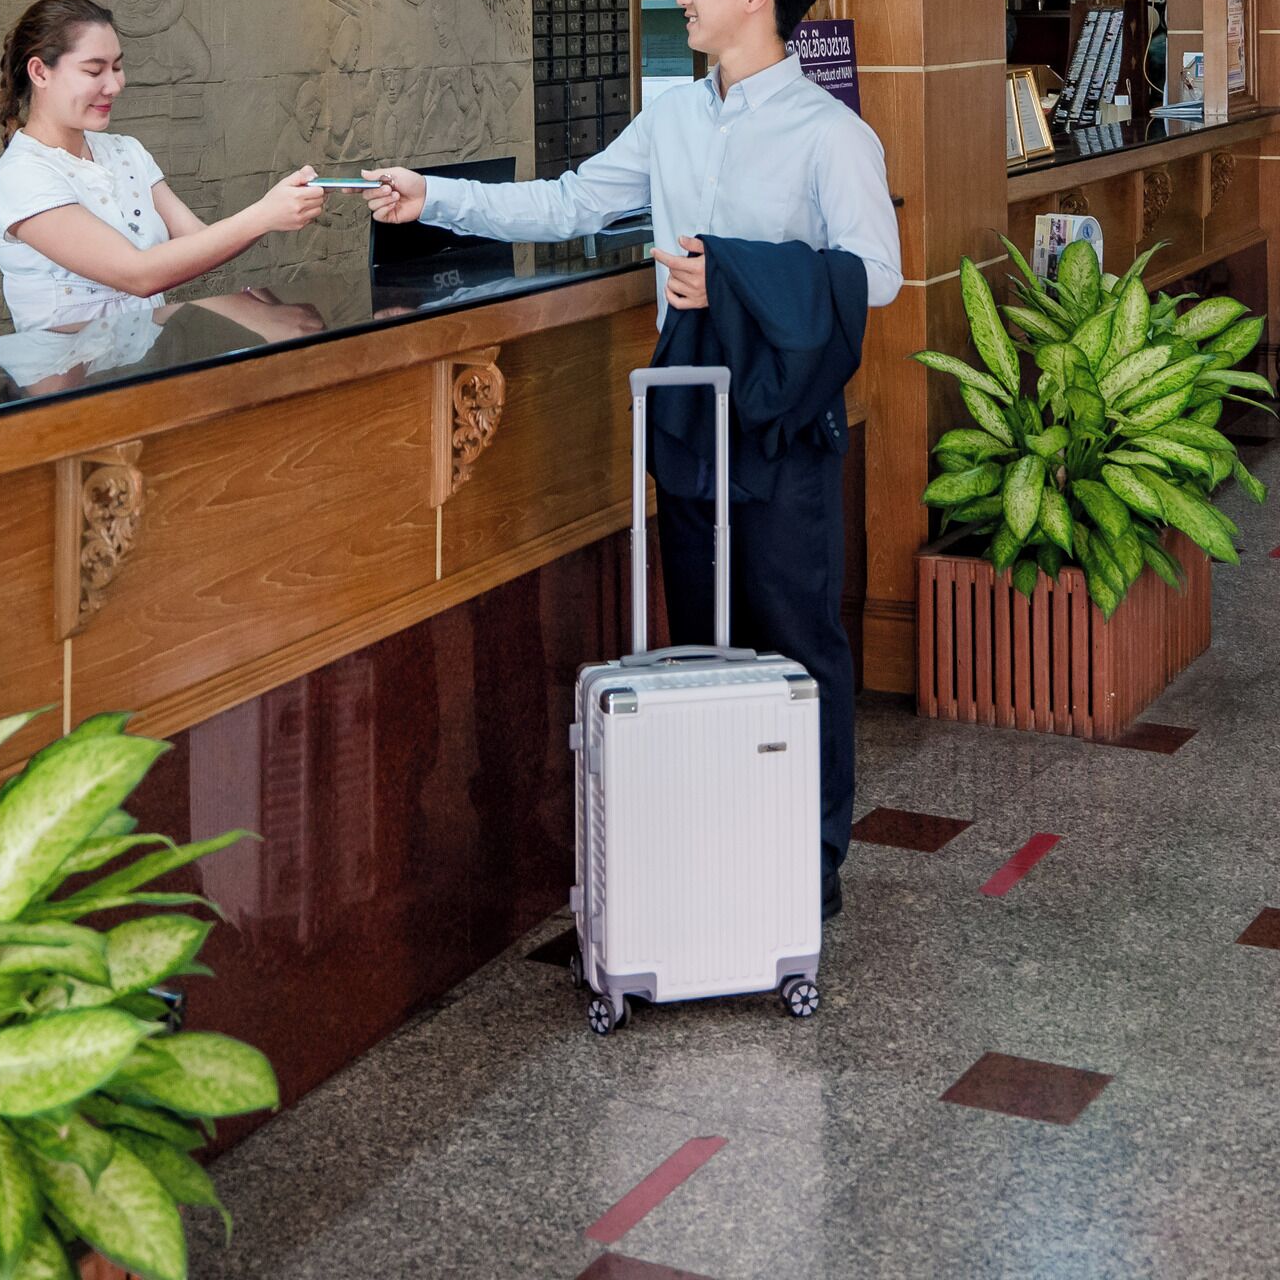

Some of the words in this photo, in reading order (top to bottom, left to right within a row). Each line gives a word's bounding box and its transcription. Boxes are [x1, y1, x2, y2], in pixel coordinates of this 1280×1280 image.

[785, 26, 851, 59] องดีเมืองน่าน
[816, 67, 836, 82] Product
